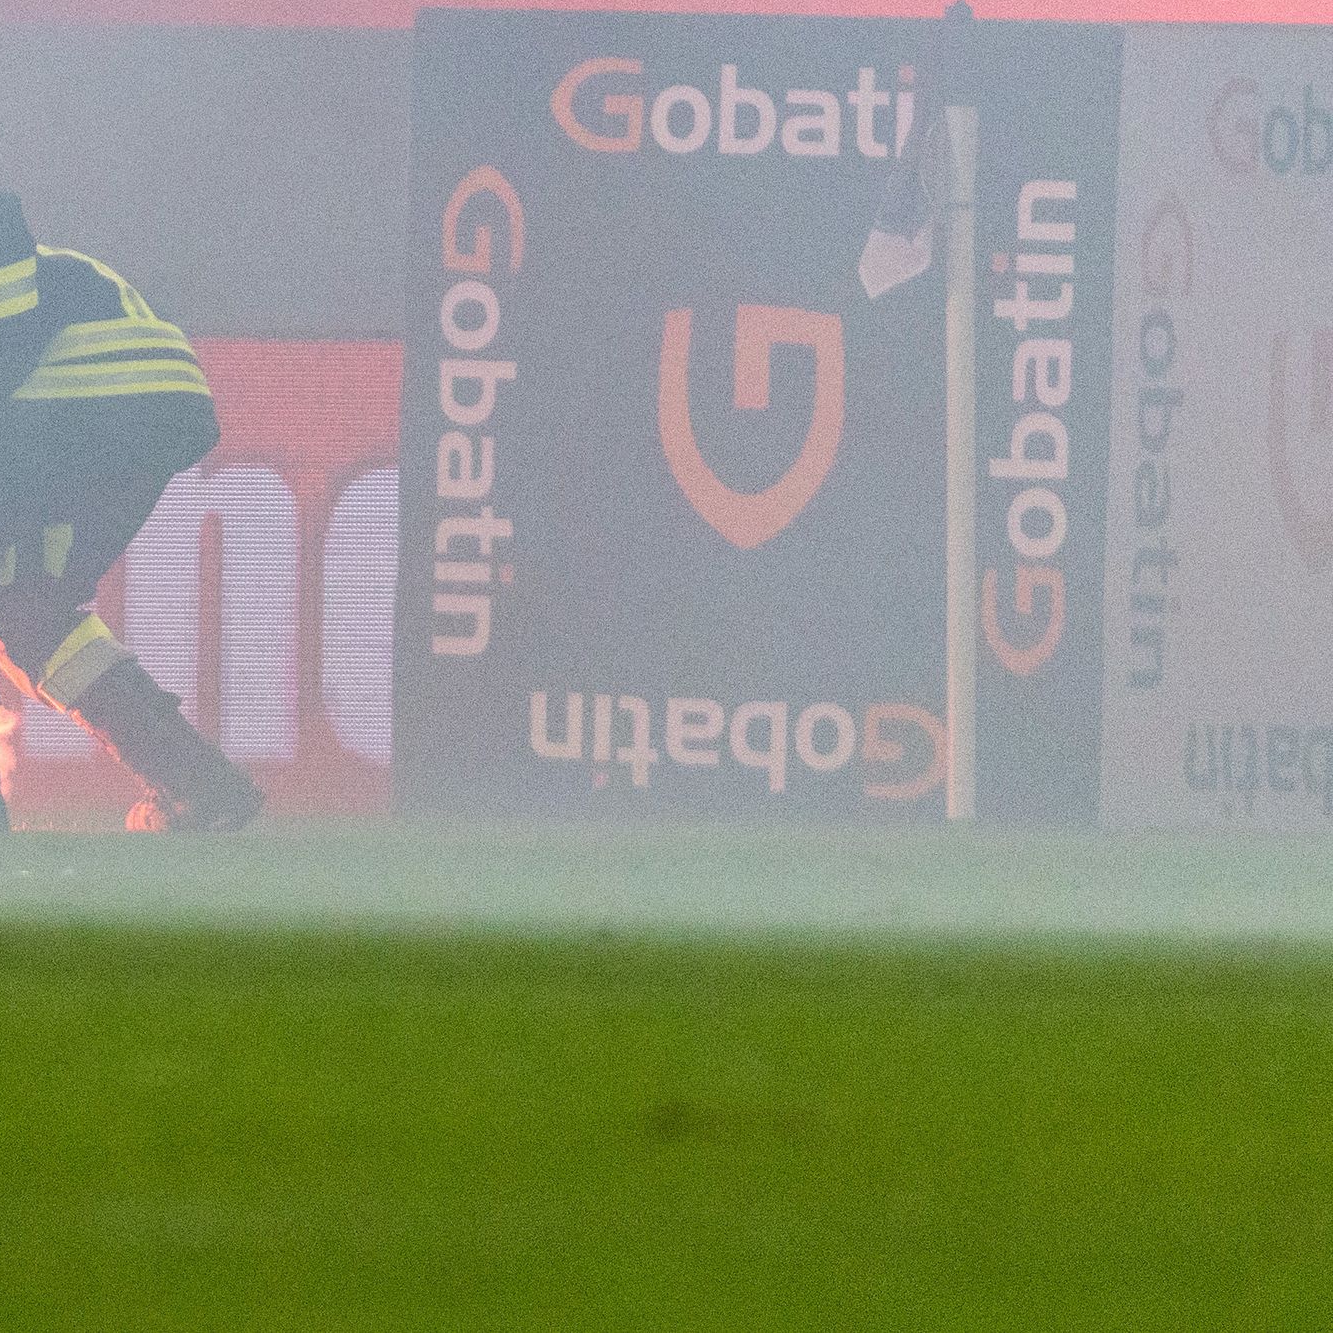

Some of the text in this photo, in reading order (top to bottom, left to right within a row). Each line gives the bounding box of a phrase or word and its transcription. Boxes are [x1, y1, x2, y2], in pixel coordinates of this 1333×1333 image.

[550, 56, 915, 159] Gobati
[431, 163, 525, 658] Gobatin
[981, 178, 1079, 677] Gobatin
[1127, 188, 1195, 690] Gobatin
[529, 687, 948, 800] Gobatin
